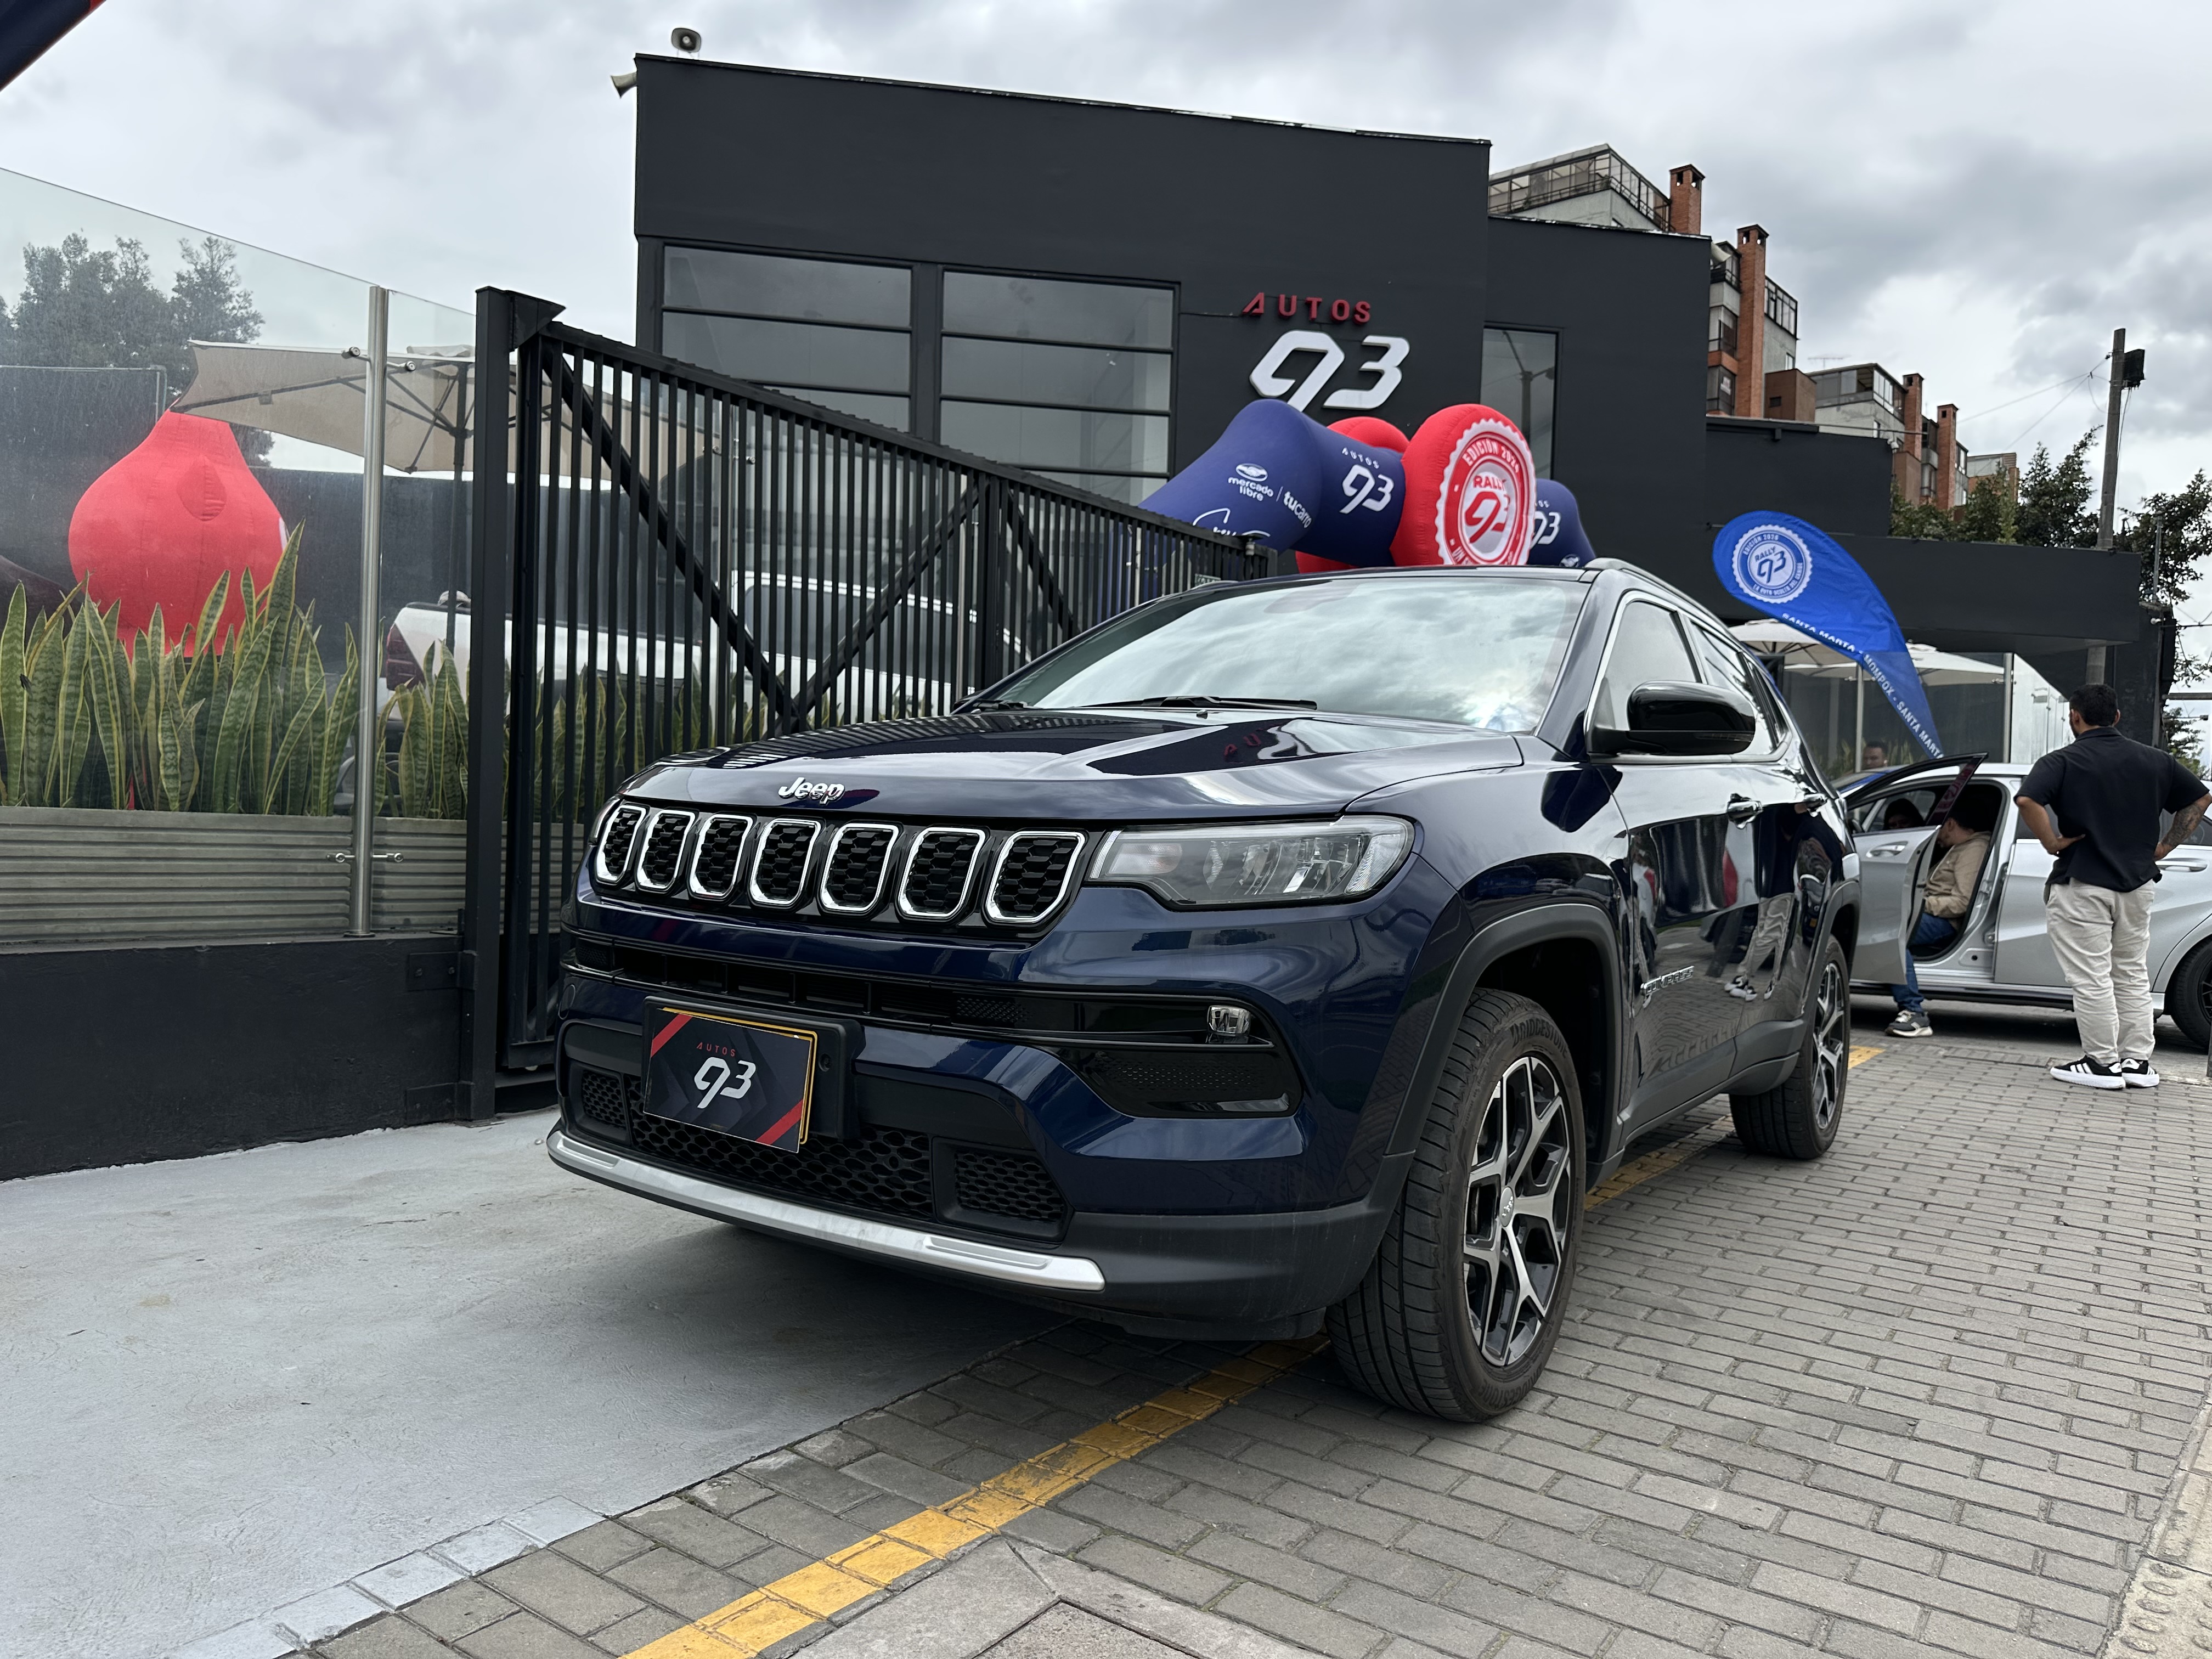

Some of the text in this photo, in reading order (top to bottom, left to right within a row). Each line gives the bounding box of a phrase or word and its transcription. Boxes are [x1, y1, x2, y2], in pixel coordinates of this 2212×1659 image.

[1242, 292, 1370, 325] AUTOS
[1249, 329, 1410, 411] 93
[1342, 447, 1380, 469] AUTOS
[1228, 477, 1274, 497] mercado
[1239, 486, 1264, 501] libre
[1339, 464, 1395, 514] 93
[1754, 545, 1776, 562] RALLY
[1757, 550, 1786, 584] 93
[1782, 612, 1817, 633] SANTA
[1819, 630, 1856, 652] MARTA
[1864, 654, 1895, 696] MOMPOX
[1897, 701, 1922, 733] SANTA
[778, 777, 845, 805] Jeep
[1640, 965, 1694, 995] COMPASS
[696, 1042, 736, 1058] AUTOS
[693, 1057, 757, 1109] 93
